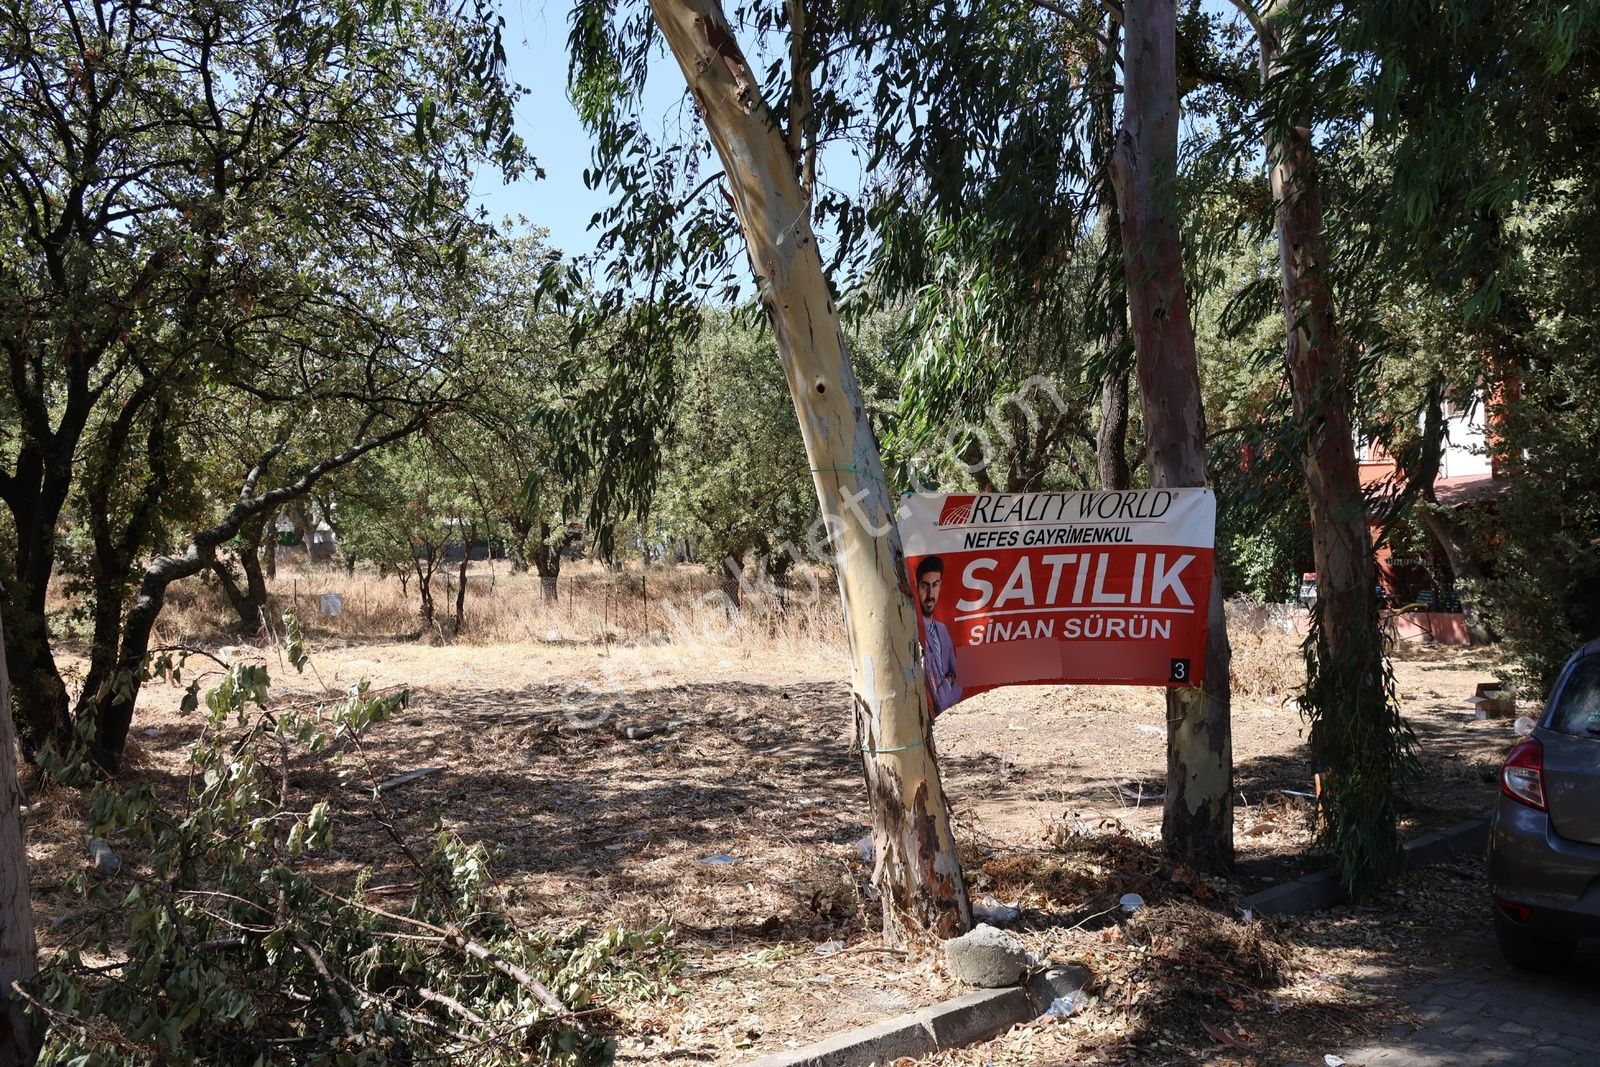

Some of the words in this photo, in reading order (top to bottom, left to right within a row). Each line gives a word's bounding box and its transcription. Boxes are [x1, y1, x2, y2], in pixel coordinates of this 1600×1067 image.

[970, 494, 1077, 524] REALTY
[964, 531, 1019, 549] NEFES
[1023, 525, 1133, 545] GAYRİMENKUL
[956, 552, 1196, 612] SATILIK
[968, 619, 1054, 646] SİNAN
[1063, 614, 1171, 640] SÜRÜN
[1174, 662, 1185, 679] 3
